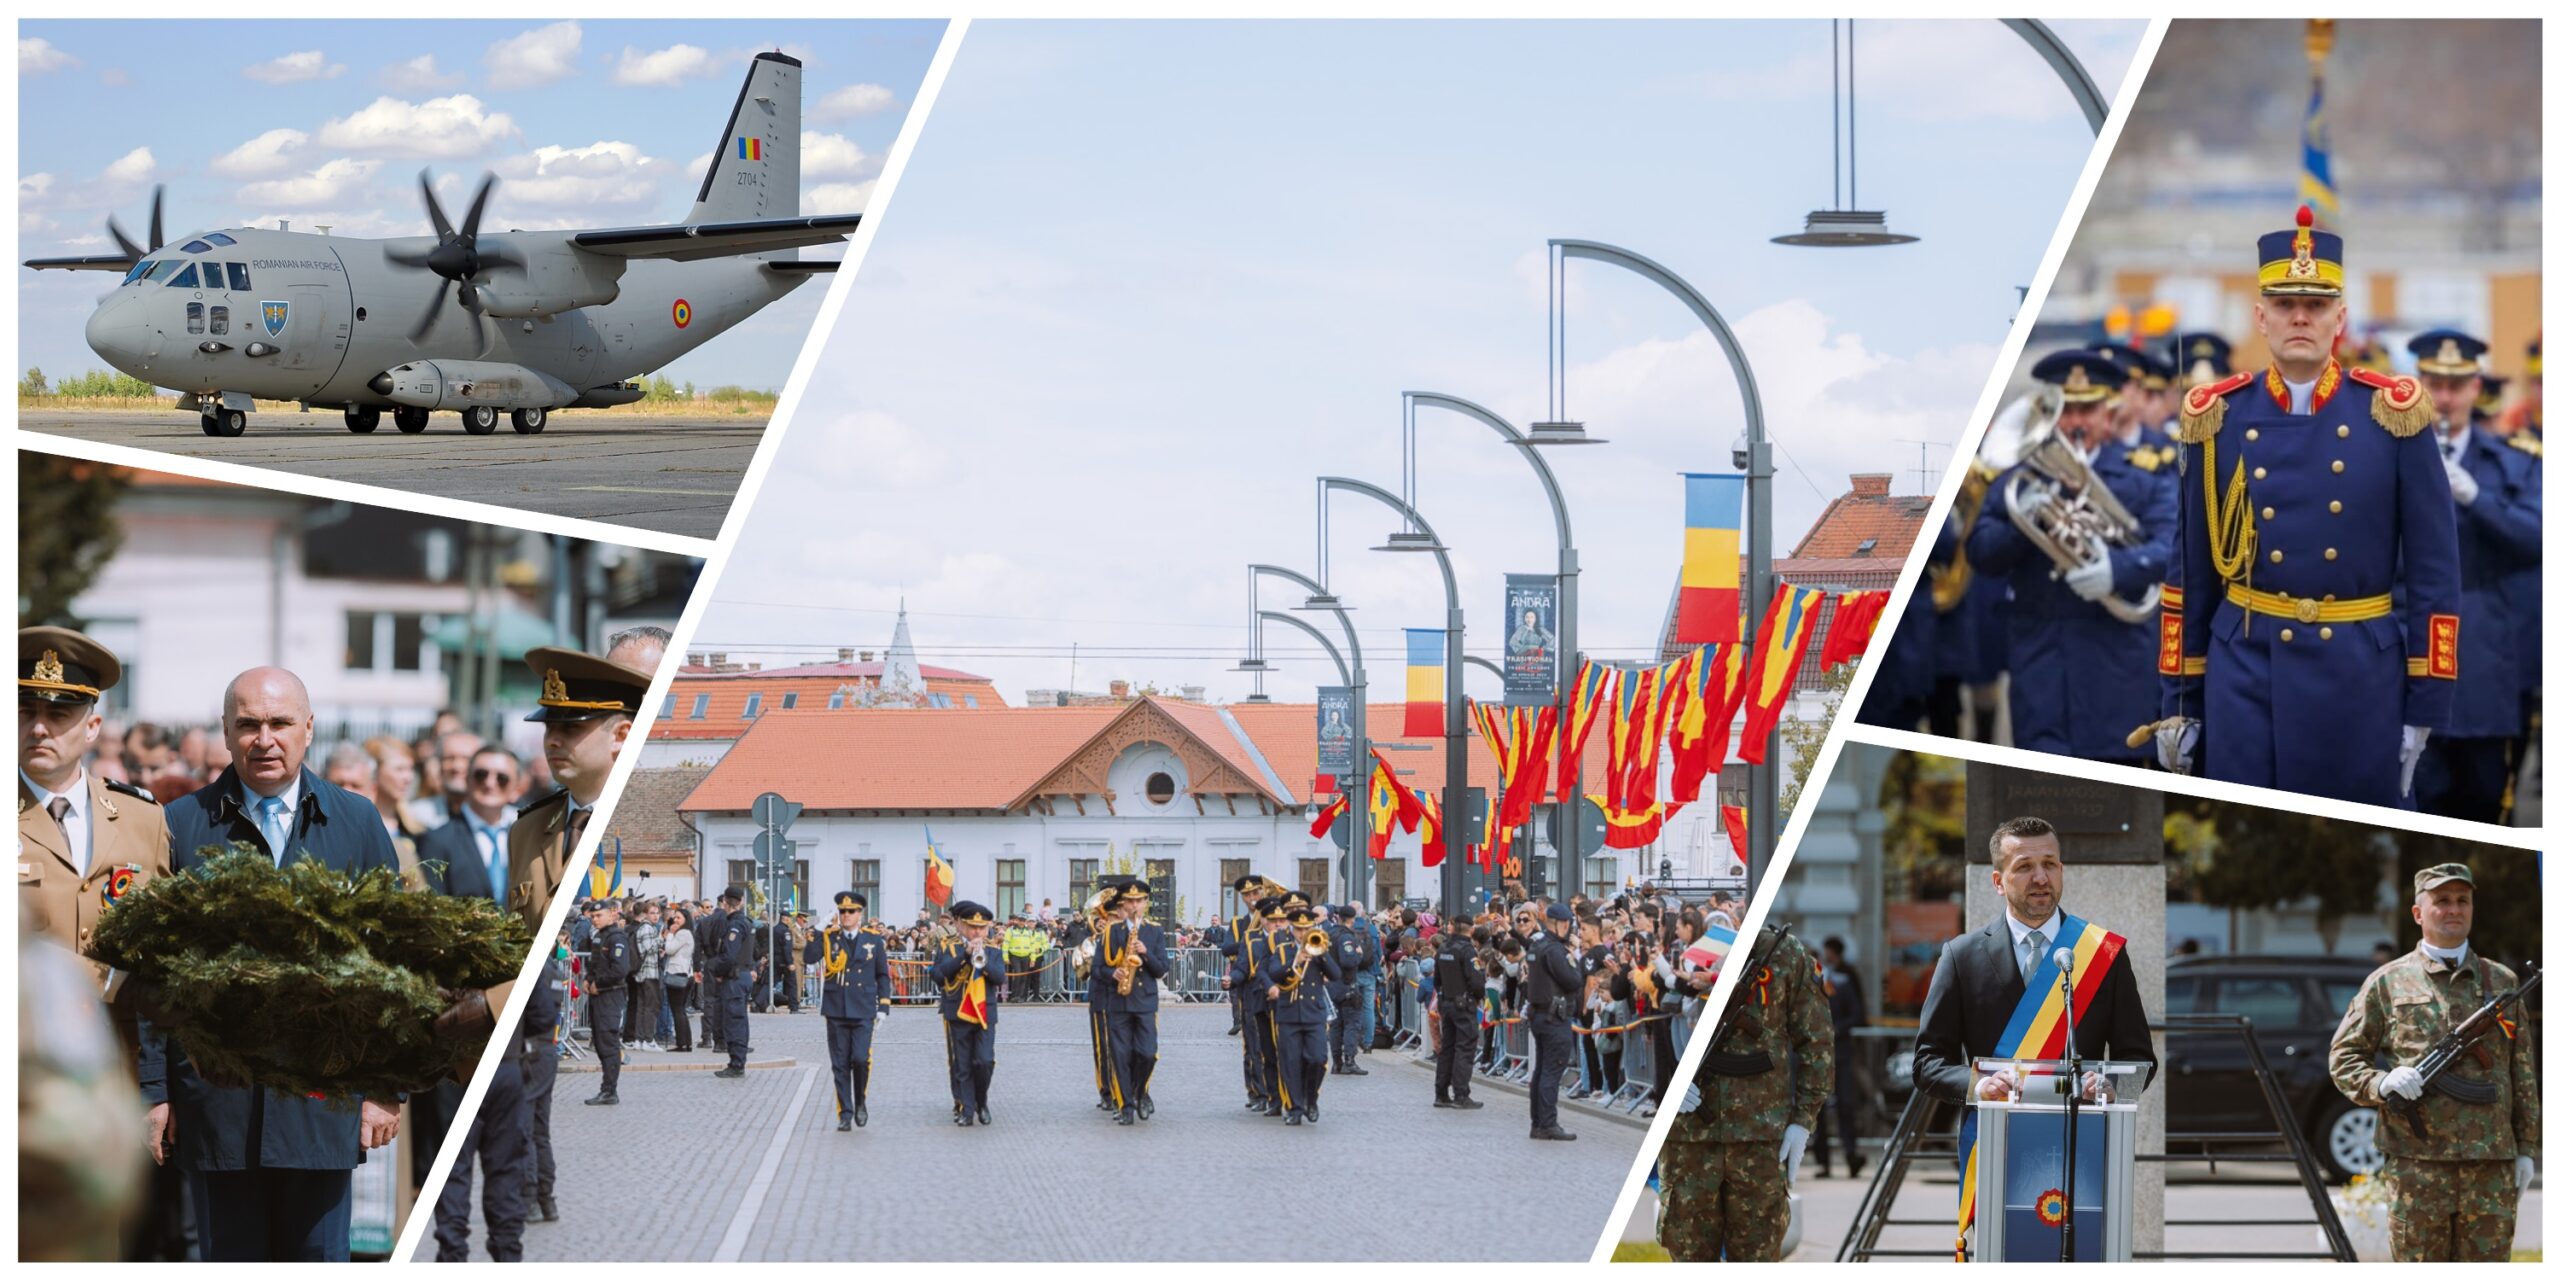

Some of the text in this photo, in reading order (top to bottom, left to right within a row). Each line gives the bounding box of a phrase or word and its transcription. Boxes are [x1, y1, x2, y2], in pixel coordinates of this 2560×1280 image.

[737, 171, 757, 186] 2704
[252, 259, 342, 272] ROMANIAN AIR FORCE
[2394, 380, 2414, 397] 30
[1511, 596, 1551, 608] ANDRA
